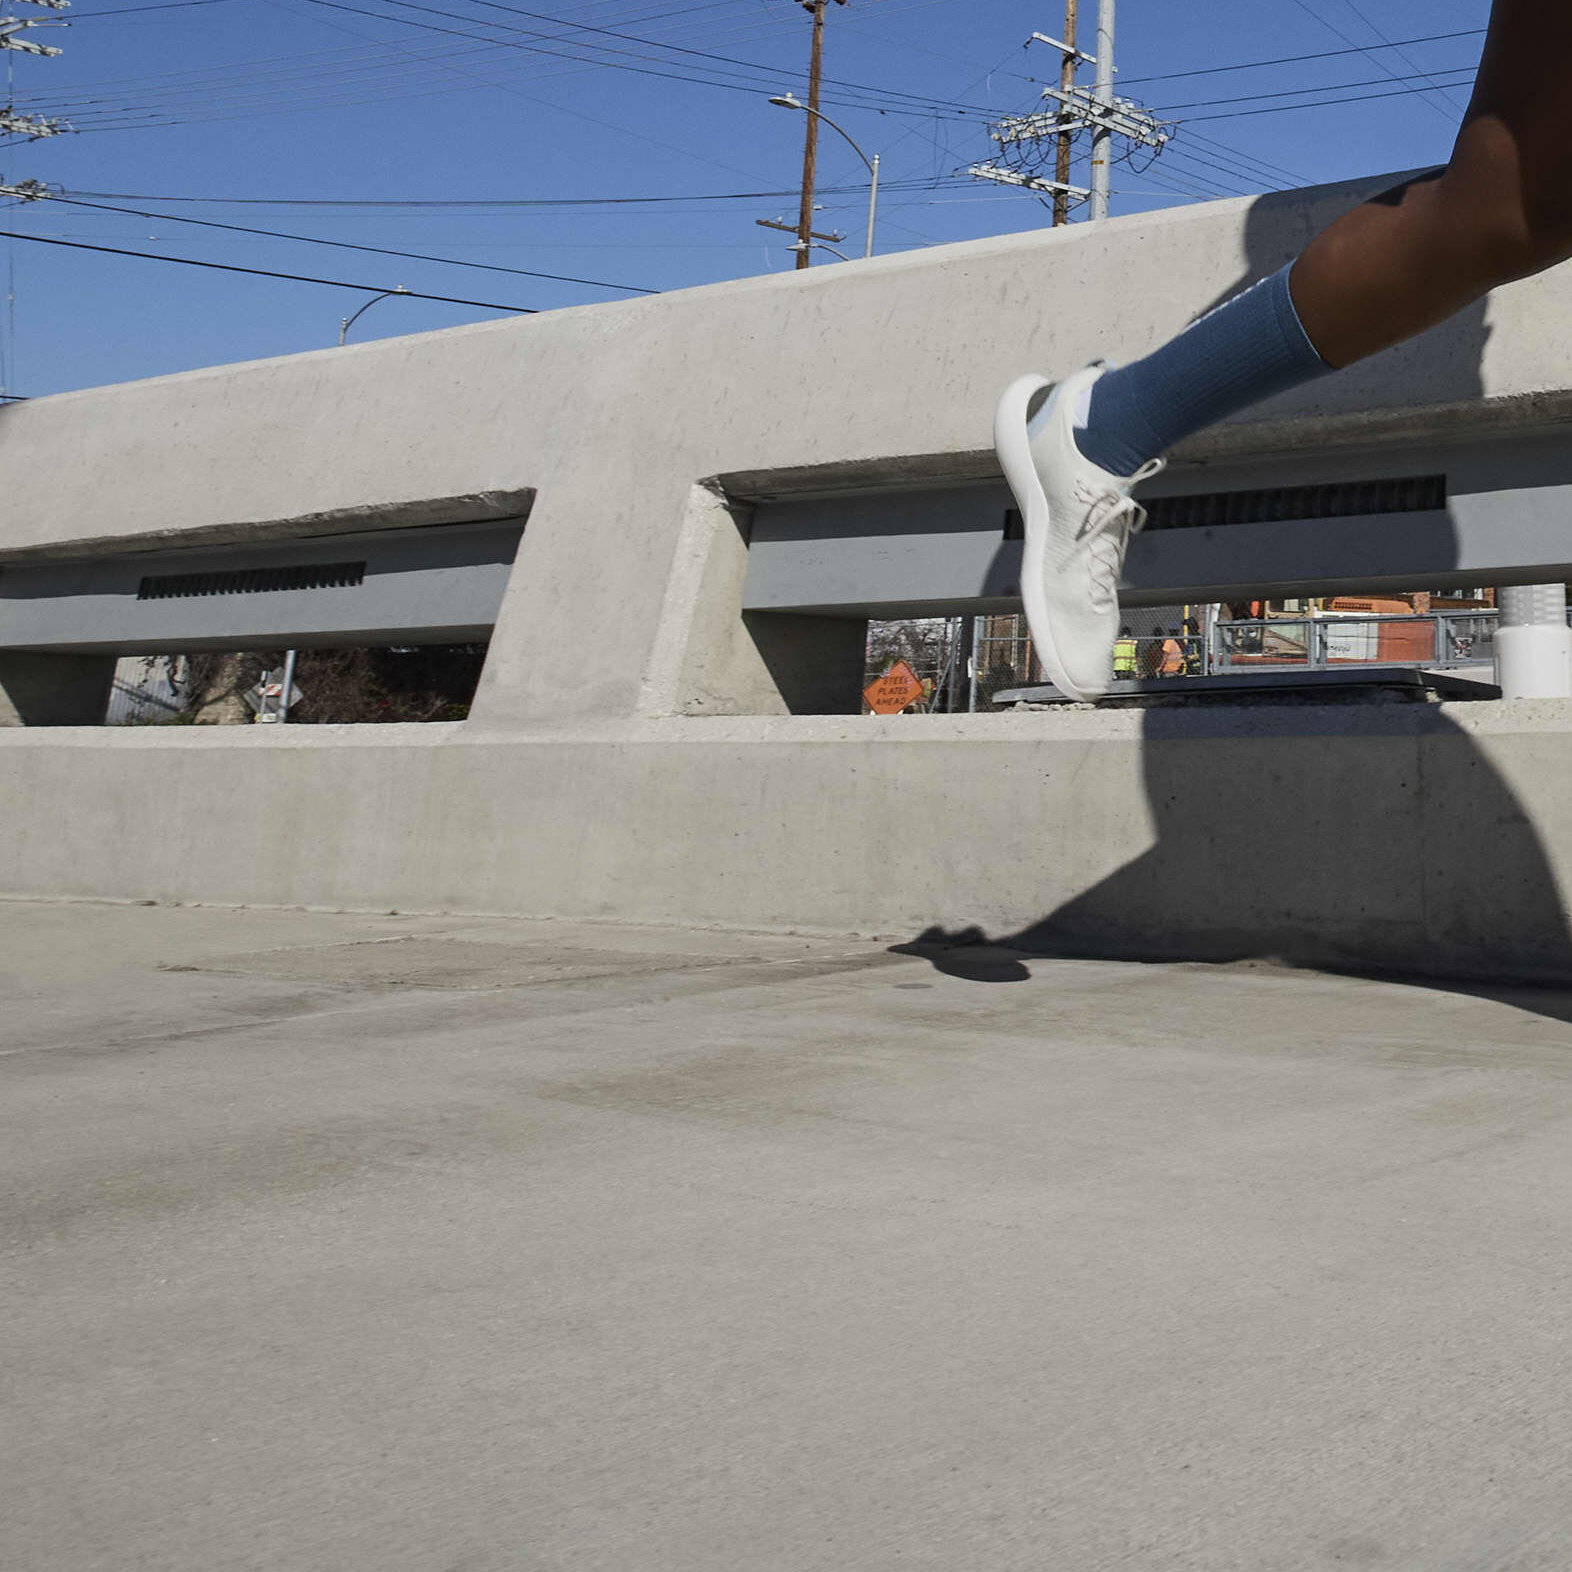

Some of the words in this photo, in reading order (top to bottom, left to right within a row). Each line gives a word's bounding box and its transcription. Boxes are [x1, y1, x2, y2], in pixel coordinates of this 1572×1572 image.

[883, 676, 908, 685] STEEL
[878, 687, 908, 695] PLATES
[876, 697, 905, 706] AHEAD
